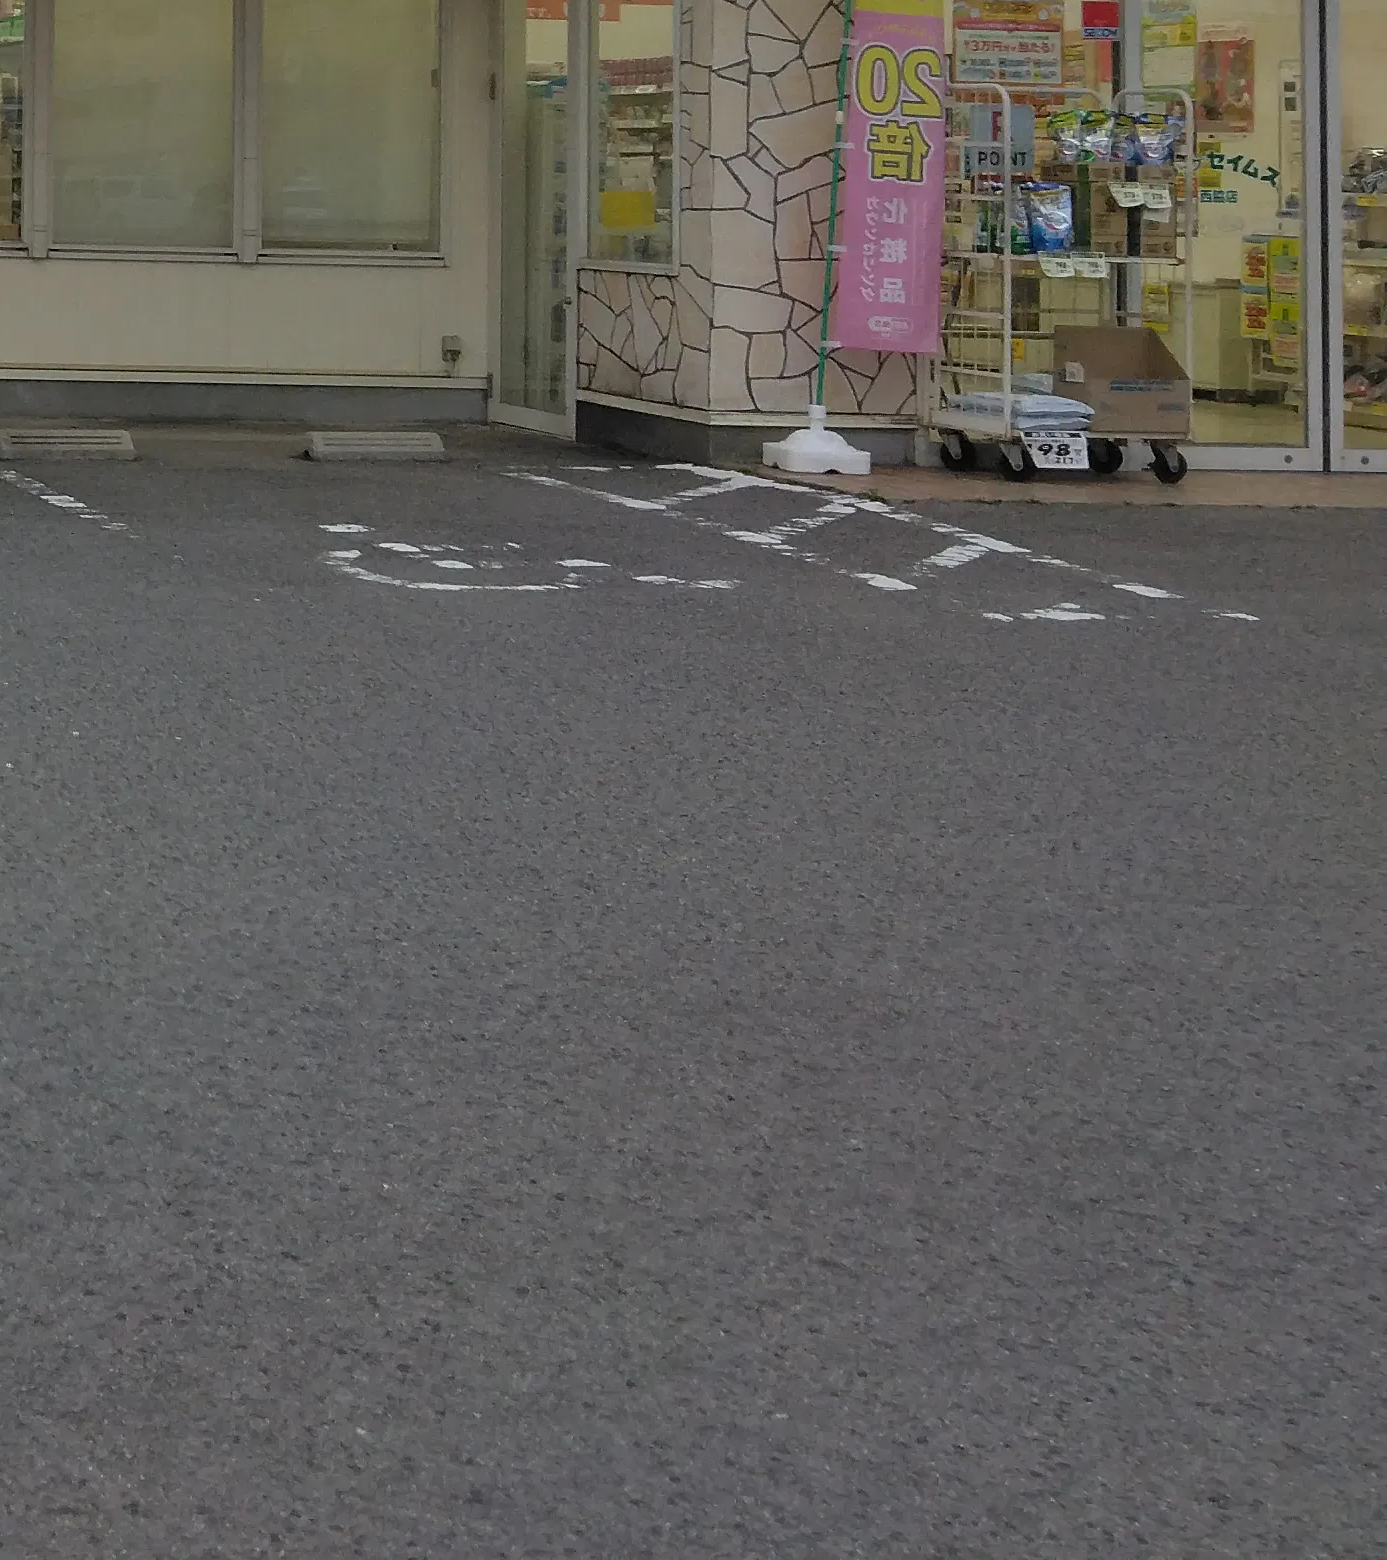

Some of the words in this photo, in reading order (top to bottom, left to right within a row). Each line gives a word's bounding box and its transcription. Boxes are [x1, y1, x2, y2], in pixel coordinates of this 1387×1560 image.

[978, 150, 1027, 167] PONT
[1206, 151, 1281, 188] セイムス
